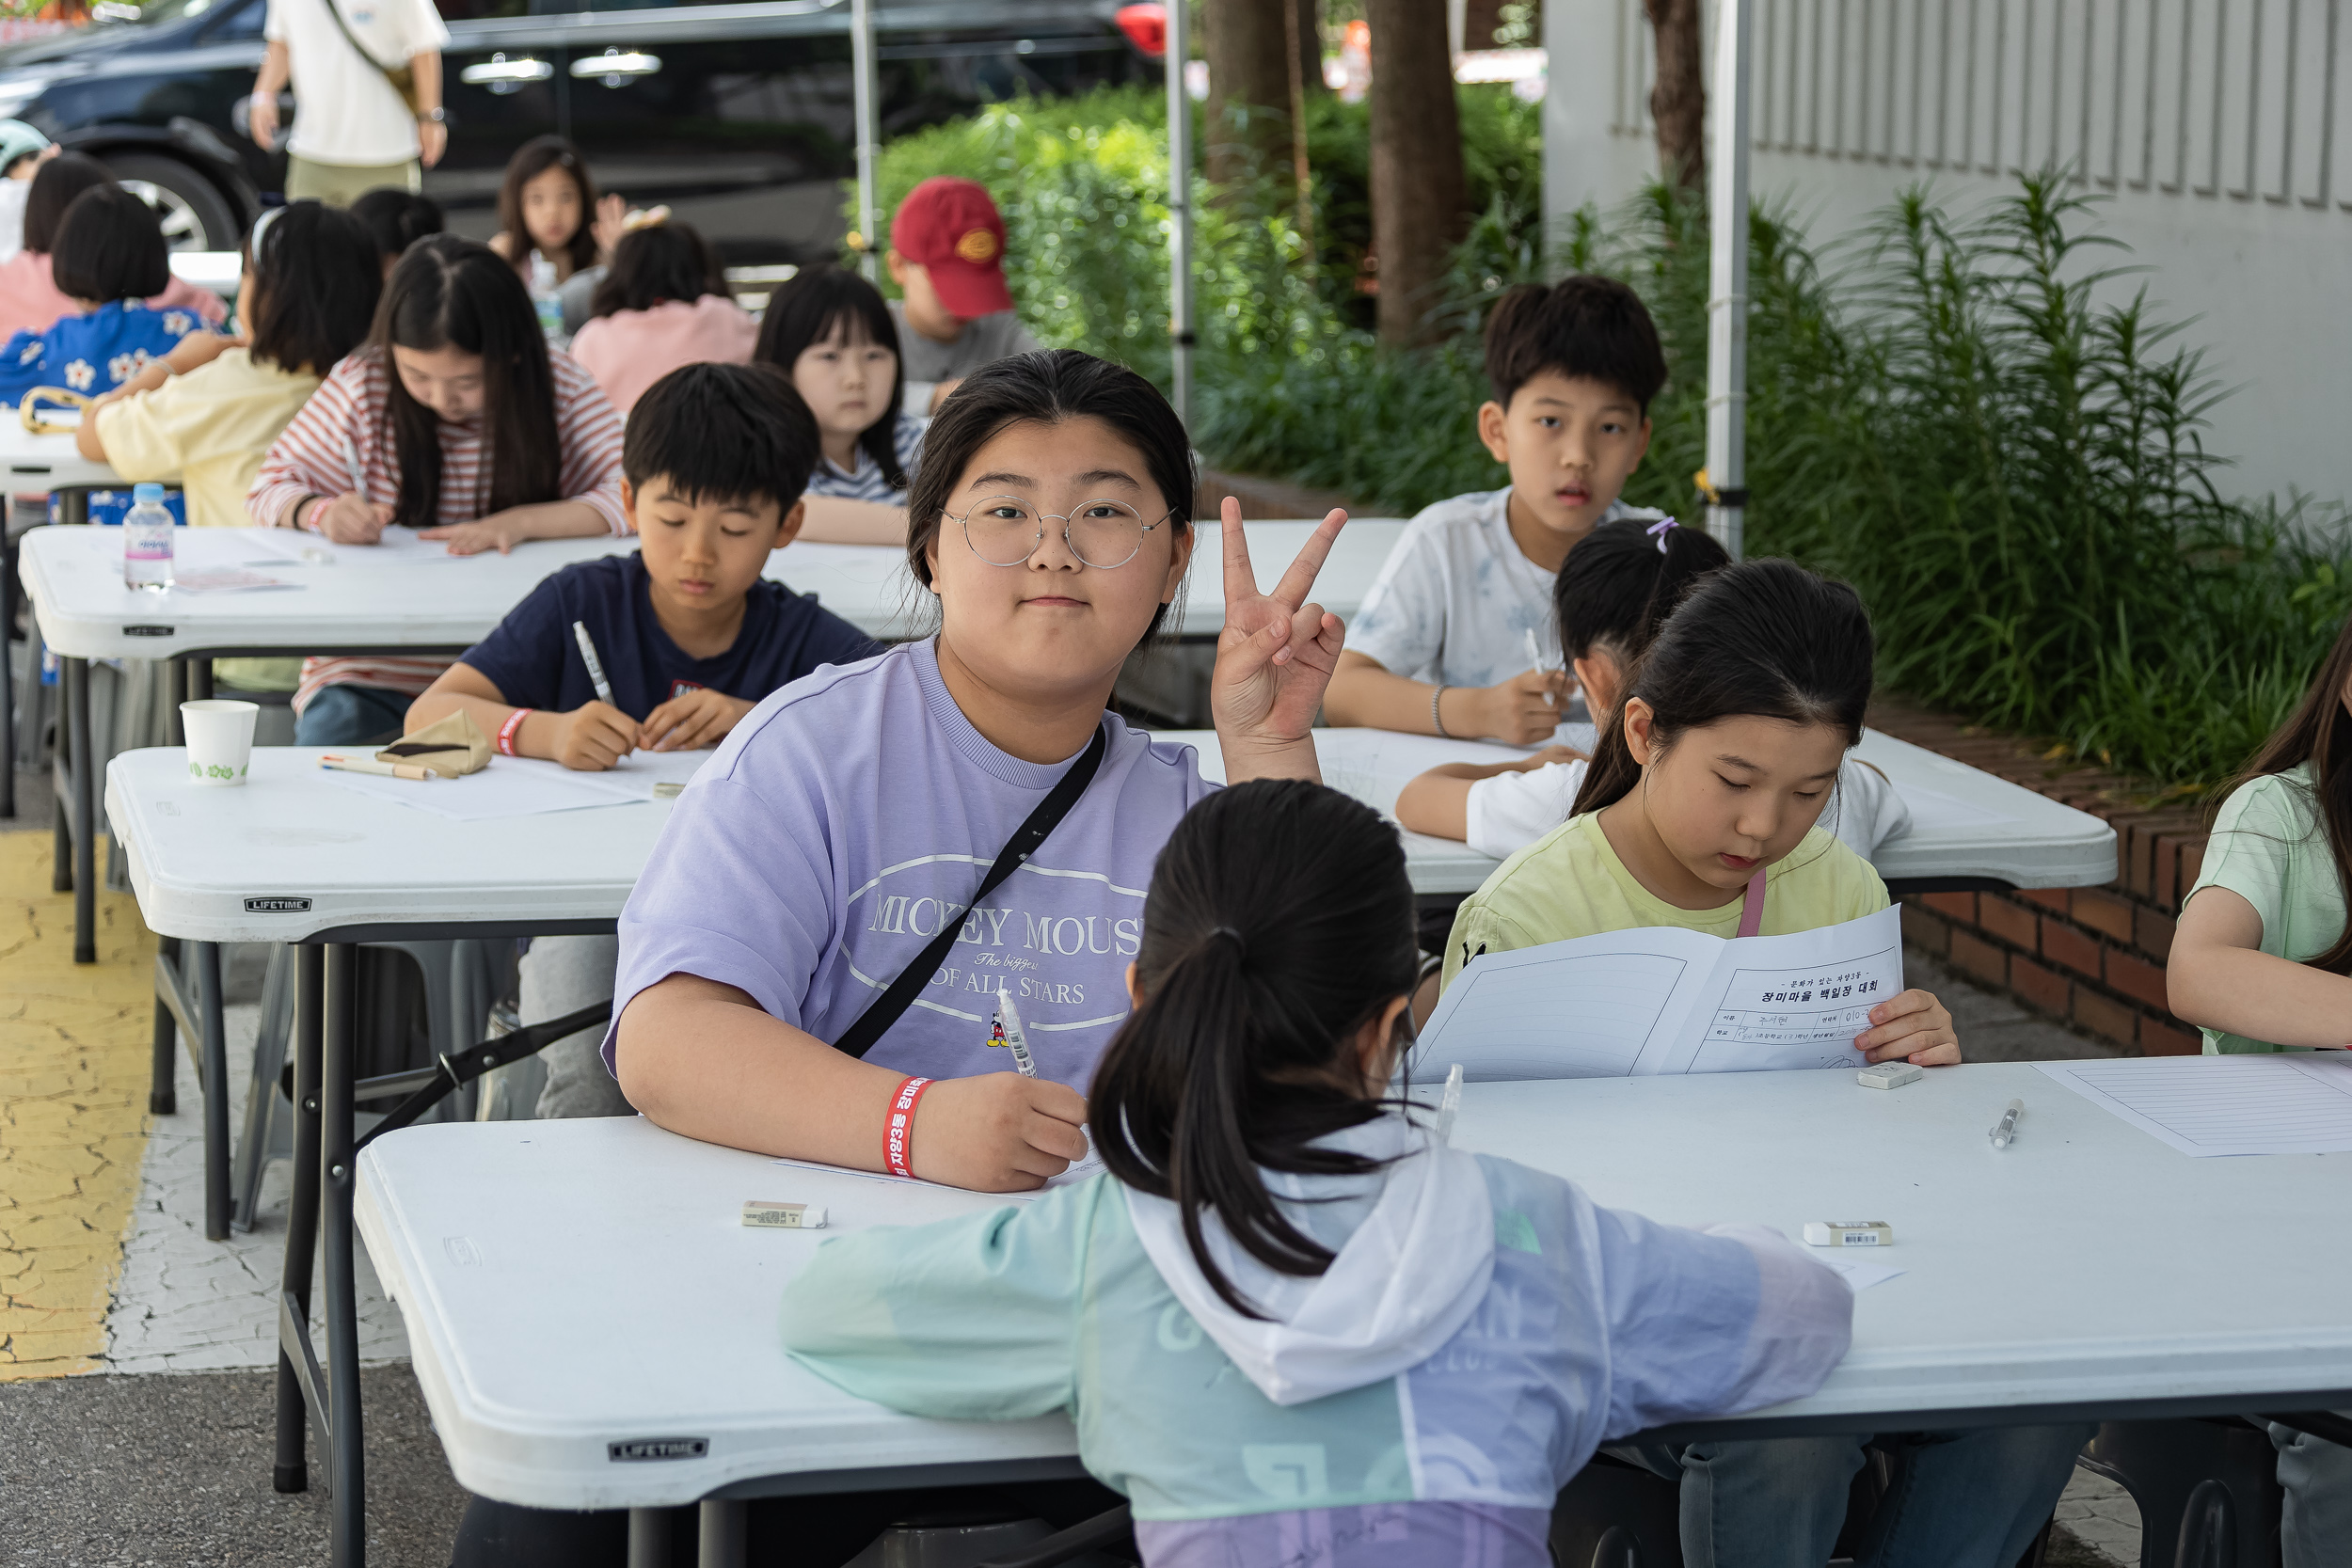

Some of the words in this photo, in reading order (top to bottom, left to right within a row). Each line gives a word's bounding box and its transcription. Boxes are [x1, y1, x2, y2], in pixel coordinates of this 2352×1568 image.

[252, 900, 304, 910] LIFETIME
[867, 895, 1013, 946] MICKEY
[1023, 911, 1145, 956] MOUS
[974, 952, 1001, 968] The
[1003, 953, 1040, 972] biggest
[930, 967, 961, 988] OF
[963, 974, 1013, 994] ALL
[1019, 976, 1085, 1005] STARS
[1761, 990, 1812, 1003] 장미마을
[1820, 984, 1852, 1000] 백일장
[1857, 979, 1879, 994] 대회
[1790, 978, 1814, 989] 문화가
[1819, 976, 1833, 987] 있는
[1836, 971, 1862, 982] 자양3동
[897, 1077, 930, 1110] 장미축
[889, 1113, 906, 1166] 자양3동
